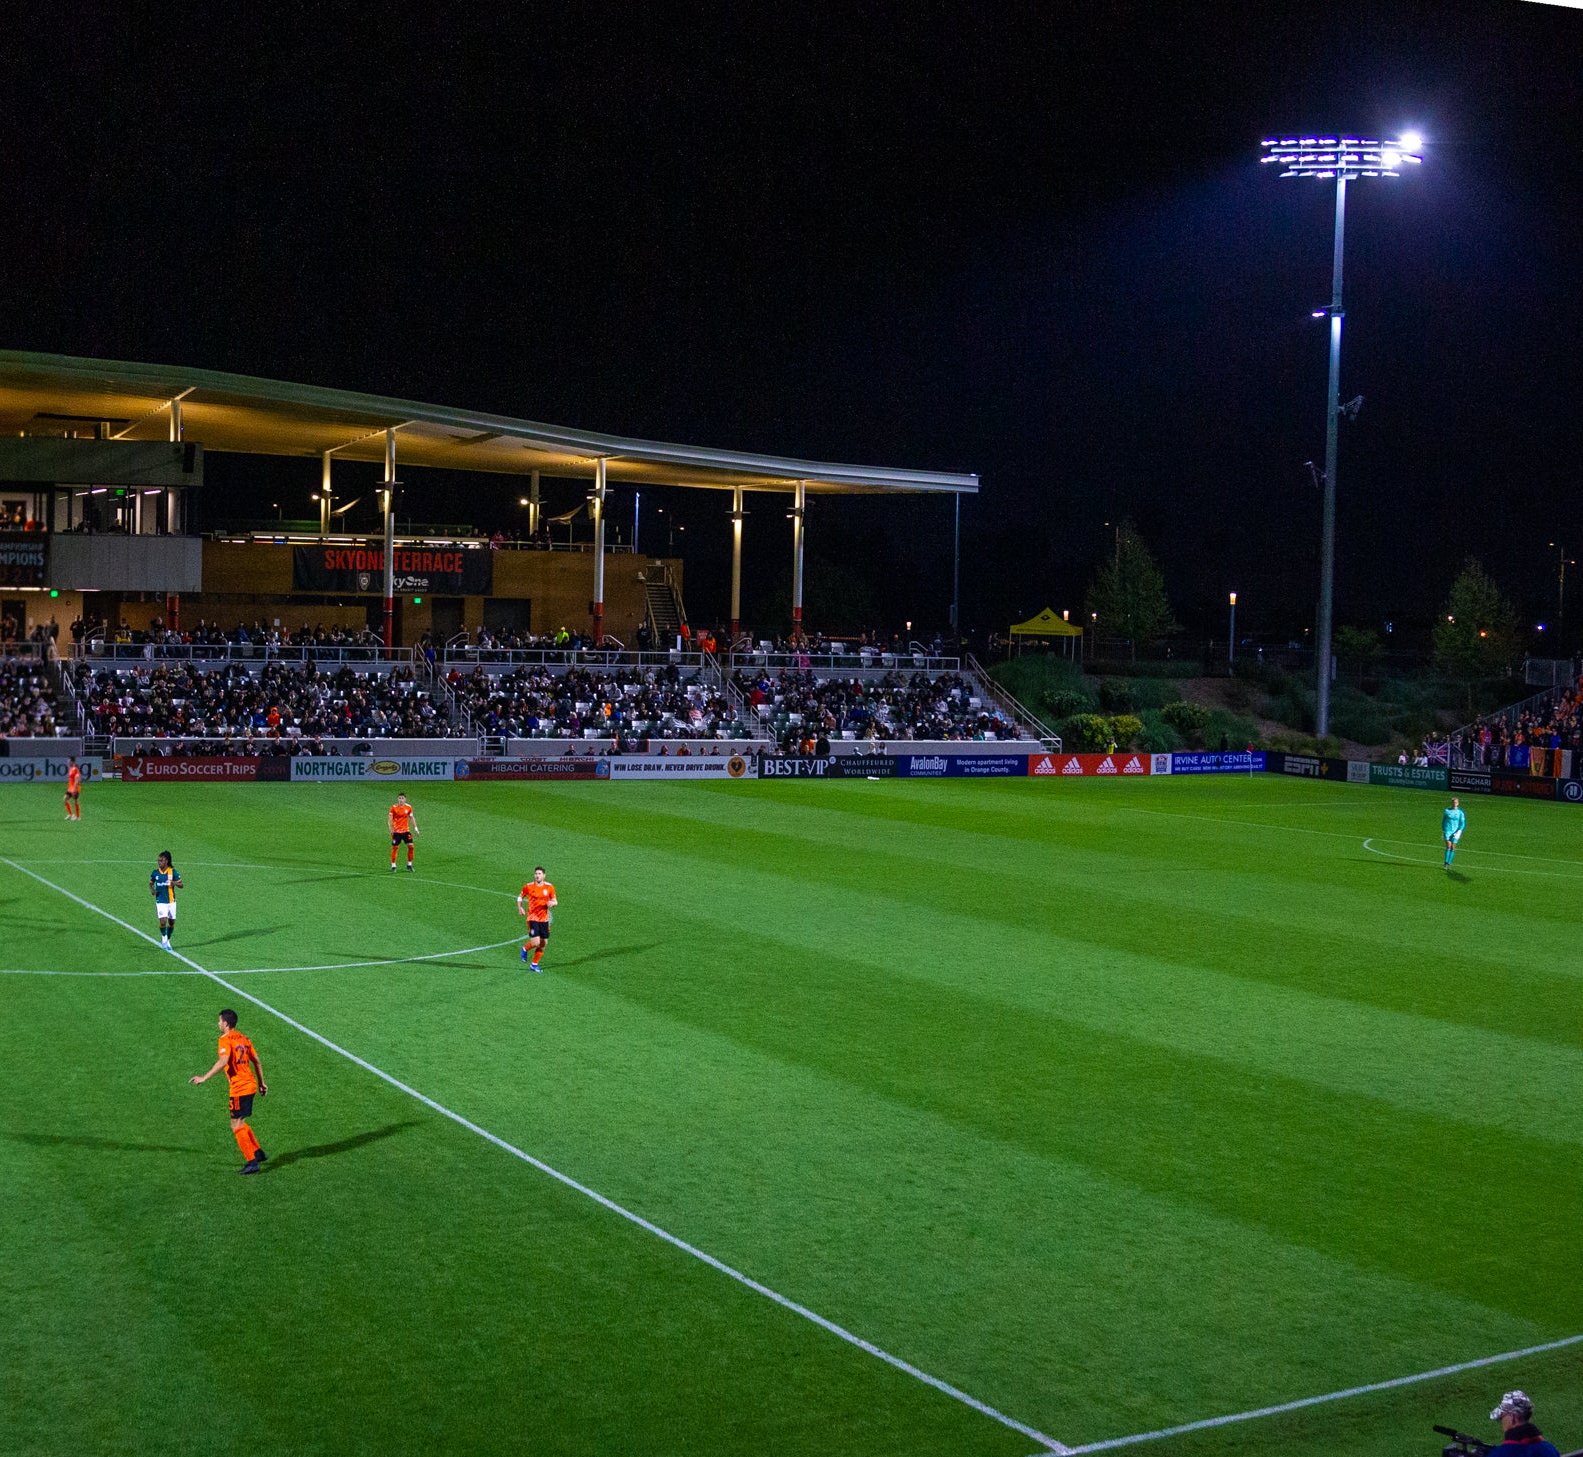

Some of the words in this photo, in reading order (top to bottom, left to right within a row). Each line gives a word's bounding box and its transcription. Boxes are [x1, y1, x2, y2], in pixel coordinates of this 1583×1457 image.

[393, 551, 464, 573] TERRACE
[393, 576, 430, 588] kyOne
[840, 758, 894, 766] CHAUFFEURED
[910, 756, 948, 772] AvalonBay
[972, 759, 1003, 768] apartment
[1004, 758, 1018, 767] living
[1174, 755, 1198, 764] IRVINE
[1201, 755, 1222, 763] AUTO
[45, 759, 99, 781] hog.
[295, 761, 365, 776] NORTHGATE
[401, 761, 448, 775] MARKET
[491, 764, 528, 773] HIBACHI
[530, 764, 575, 773] CATERING
[614, 763, 626, 771] WIN
[627, 763, 643, 772] LOSE
[665, 763, 684, 772] NEVER
[685, 763, 704, 772] DRIVE
[843, 767, 891, 775] WORLDWIDE
[970, 766, 989, 774] Orange
[1123, 766, 1144, 774] adidas
[1373, 765, 1404, 777] TRUSTS
[1404, 768, 1410, 778] &
[1412, 768, 1445, 781] ESTATES
[1451, 776, 1491, 786] ZOLFAGHARI
